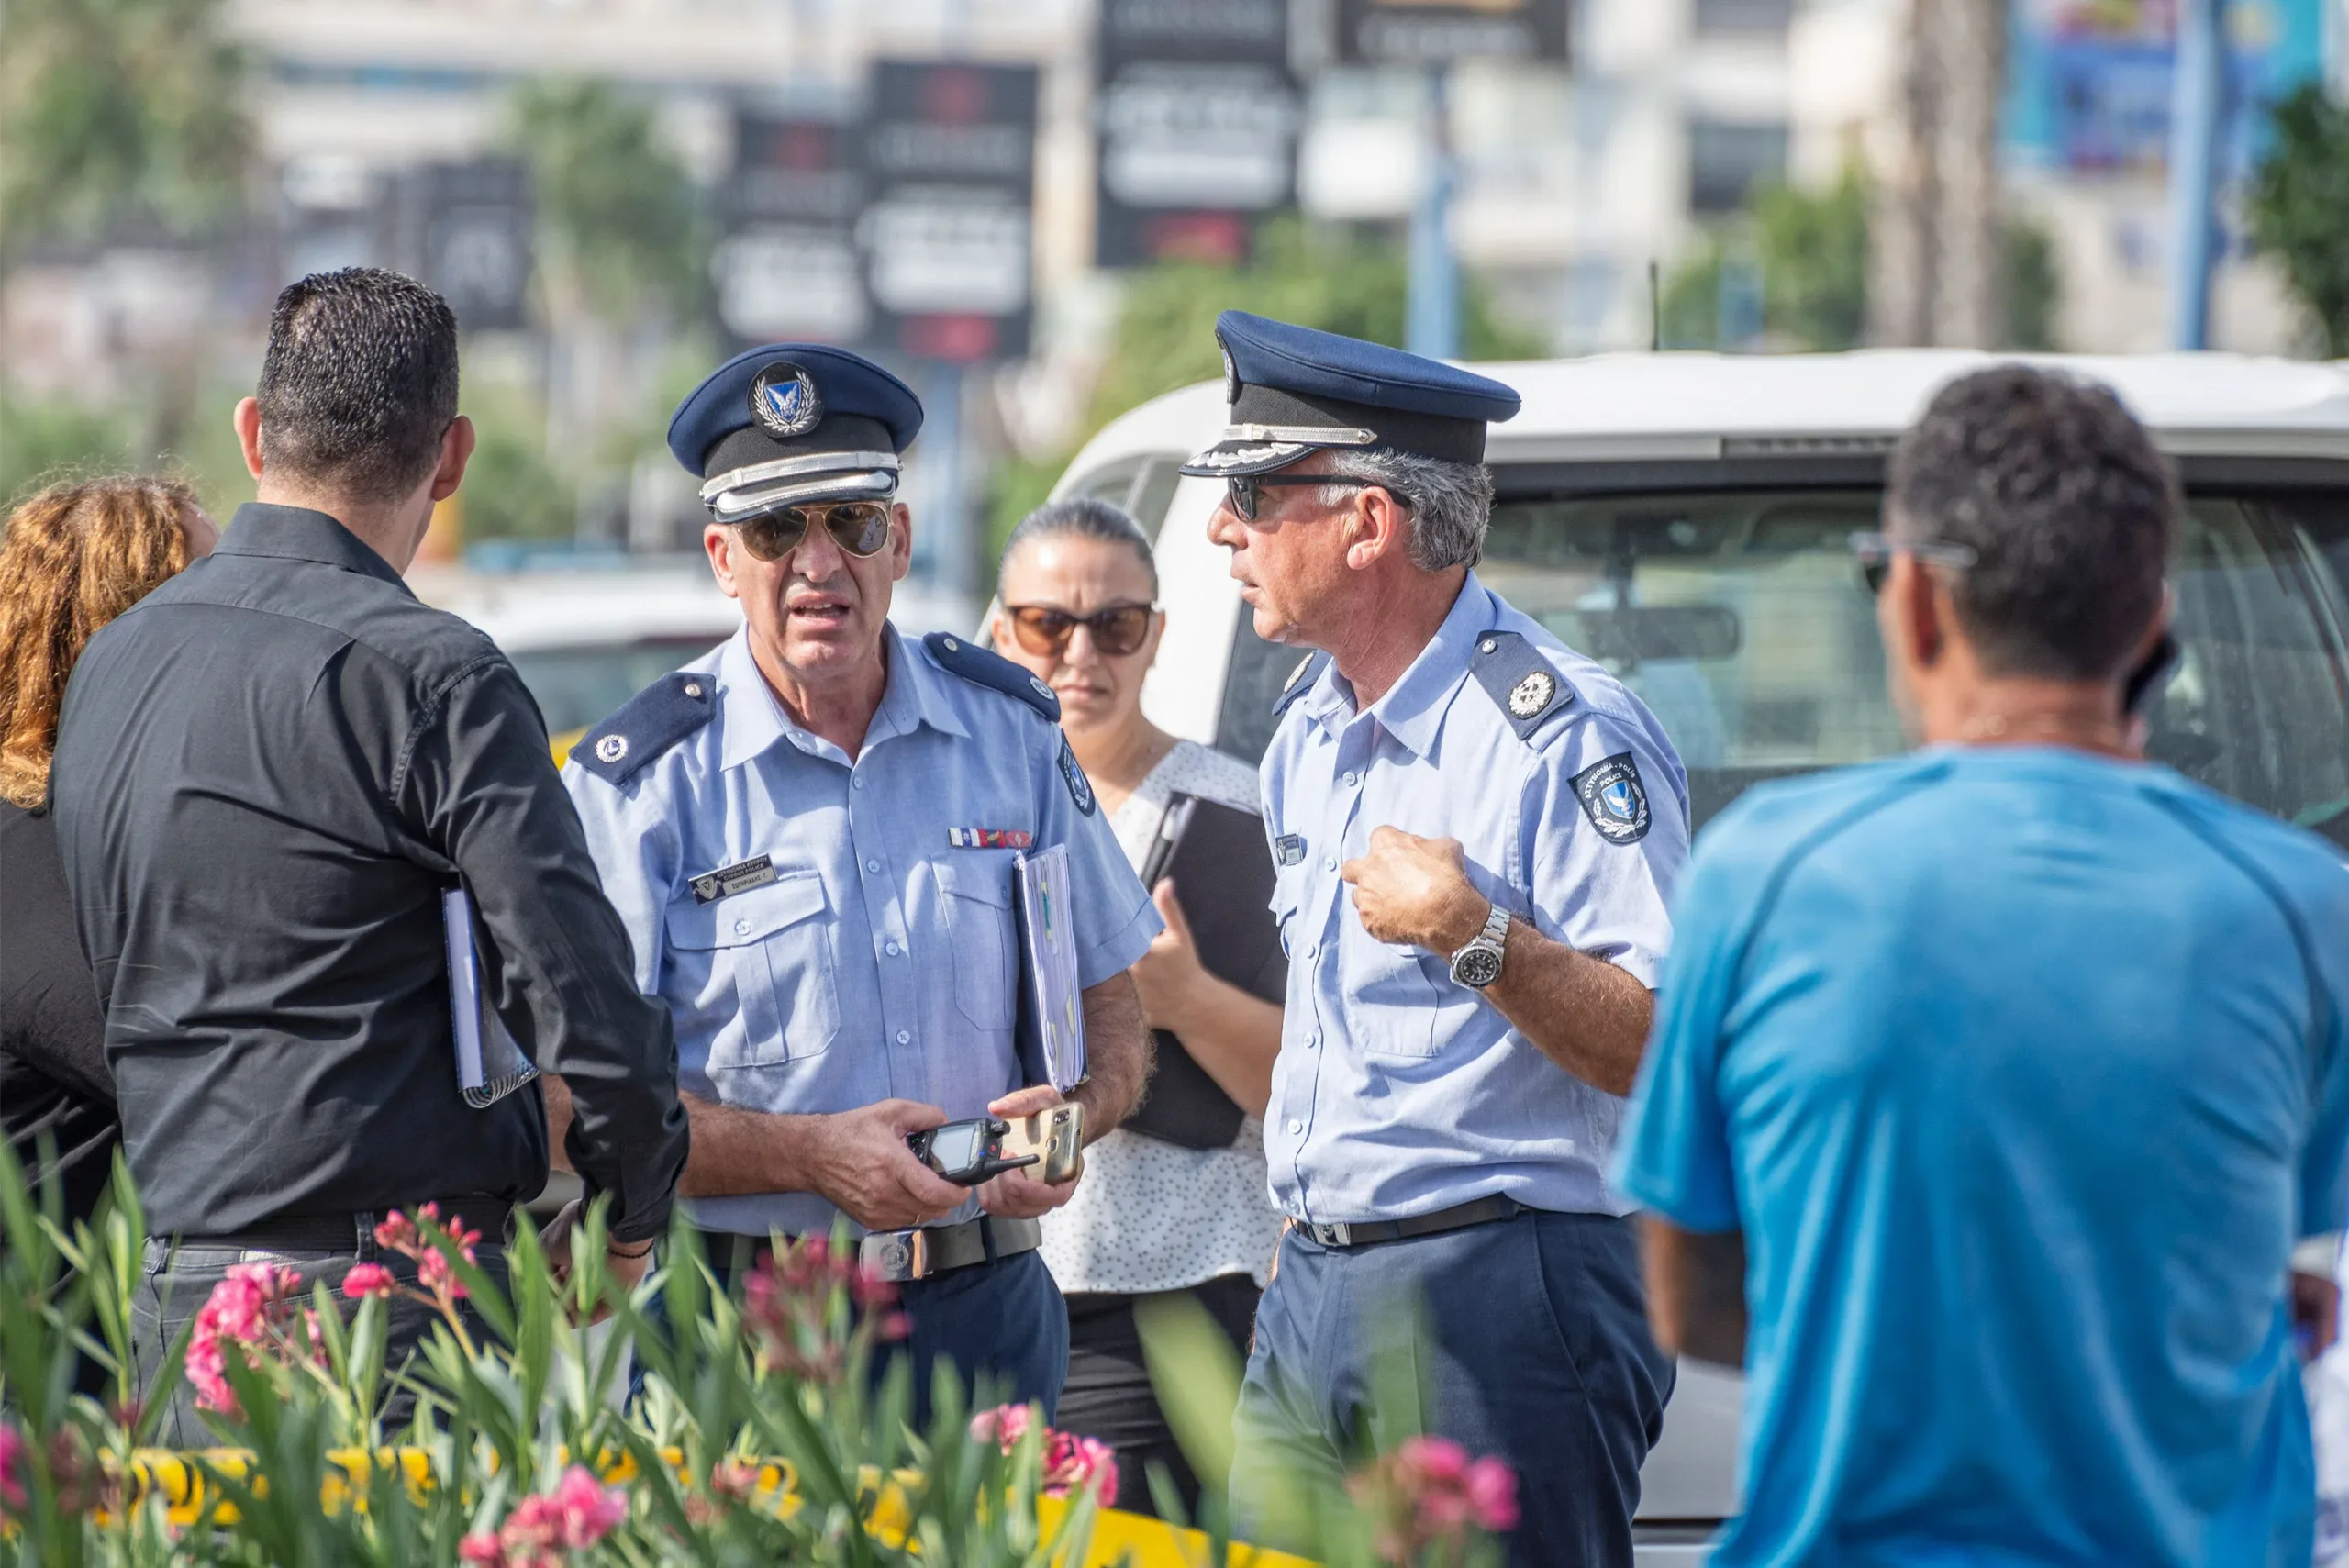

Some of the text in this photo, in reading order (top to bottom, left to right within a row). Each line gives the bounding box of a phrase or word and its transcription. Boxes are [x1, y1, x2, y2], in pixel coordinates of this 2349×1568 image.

[1599, 772, 1622, 787] POLICE
[723, 863, 763, 881] CYPRUS POLICE
